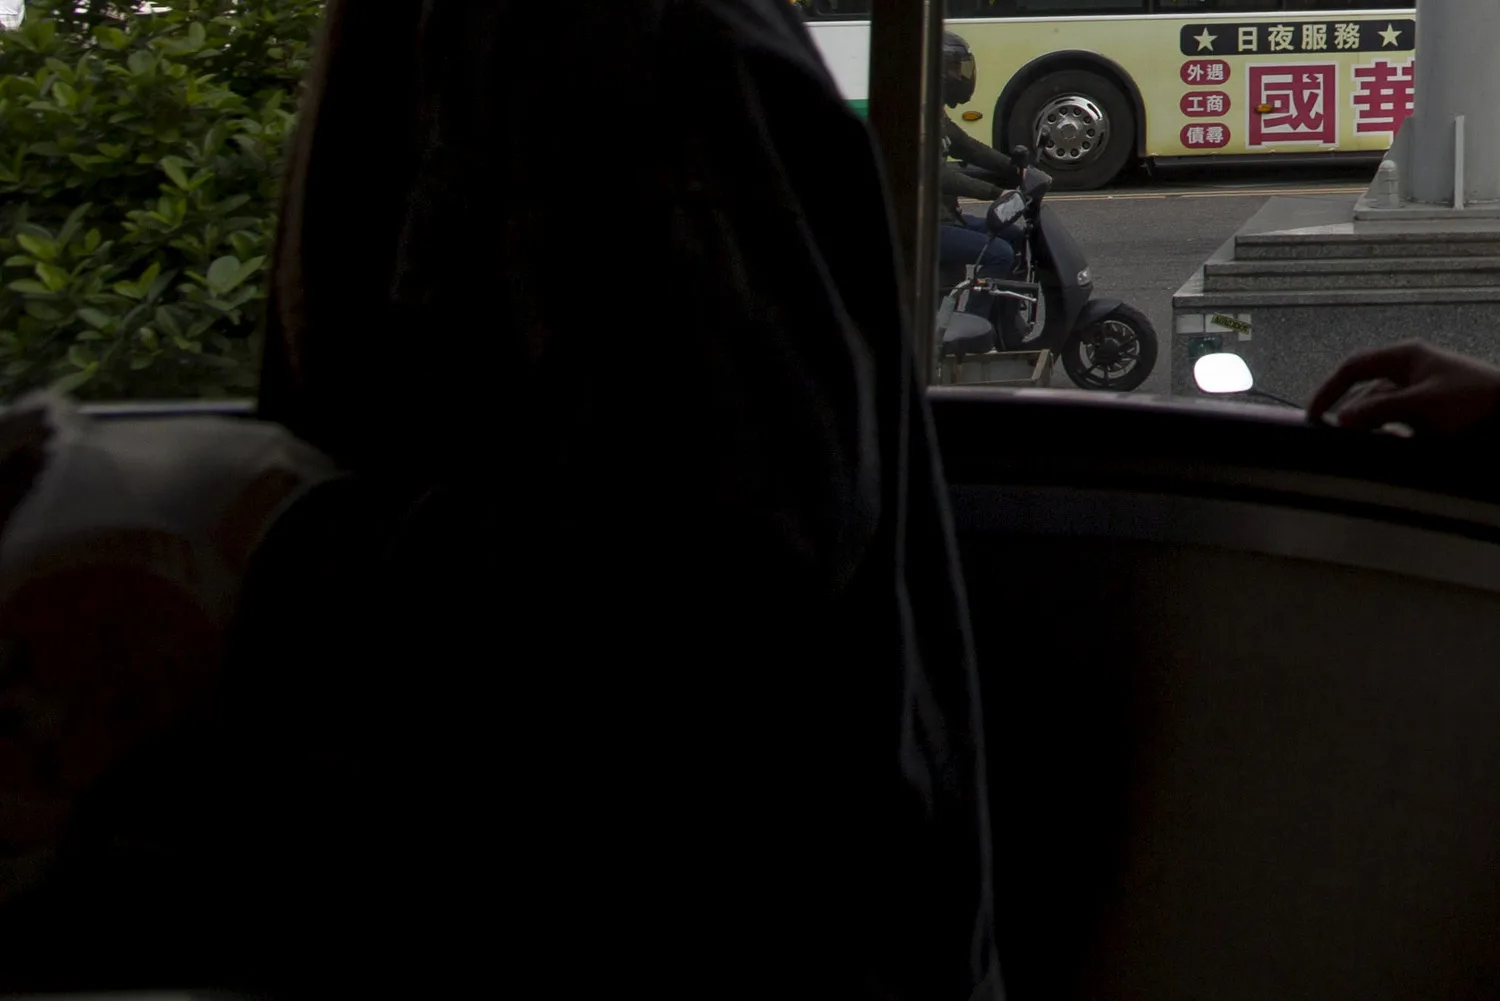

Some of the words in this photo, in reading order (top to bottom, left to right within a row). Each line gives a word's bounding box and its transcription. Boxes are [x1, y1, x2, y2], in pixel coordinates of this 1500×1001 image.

[1238, 24, 1361, 51] 日夜服務
[1187, 65, 1224, 81] 外遇
[1187, 96, 1224, 112] 工商
[1187, 128, 1224, 144] 債尋
